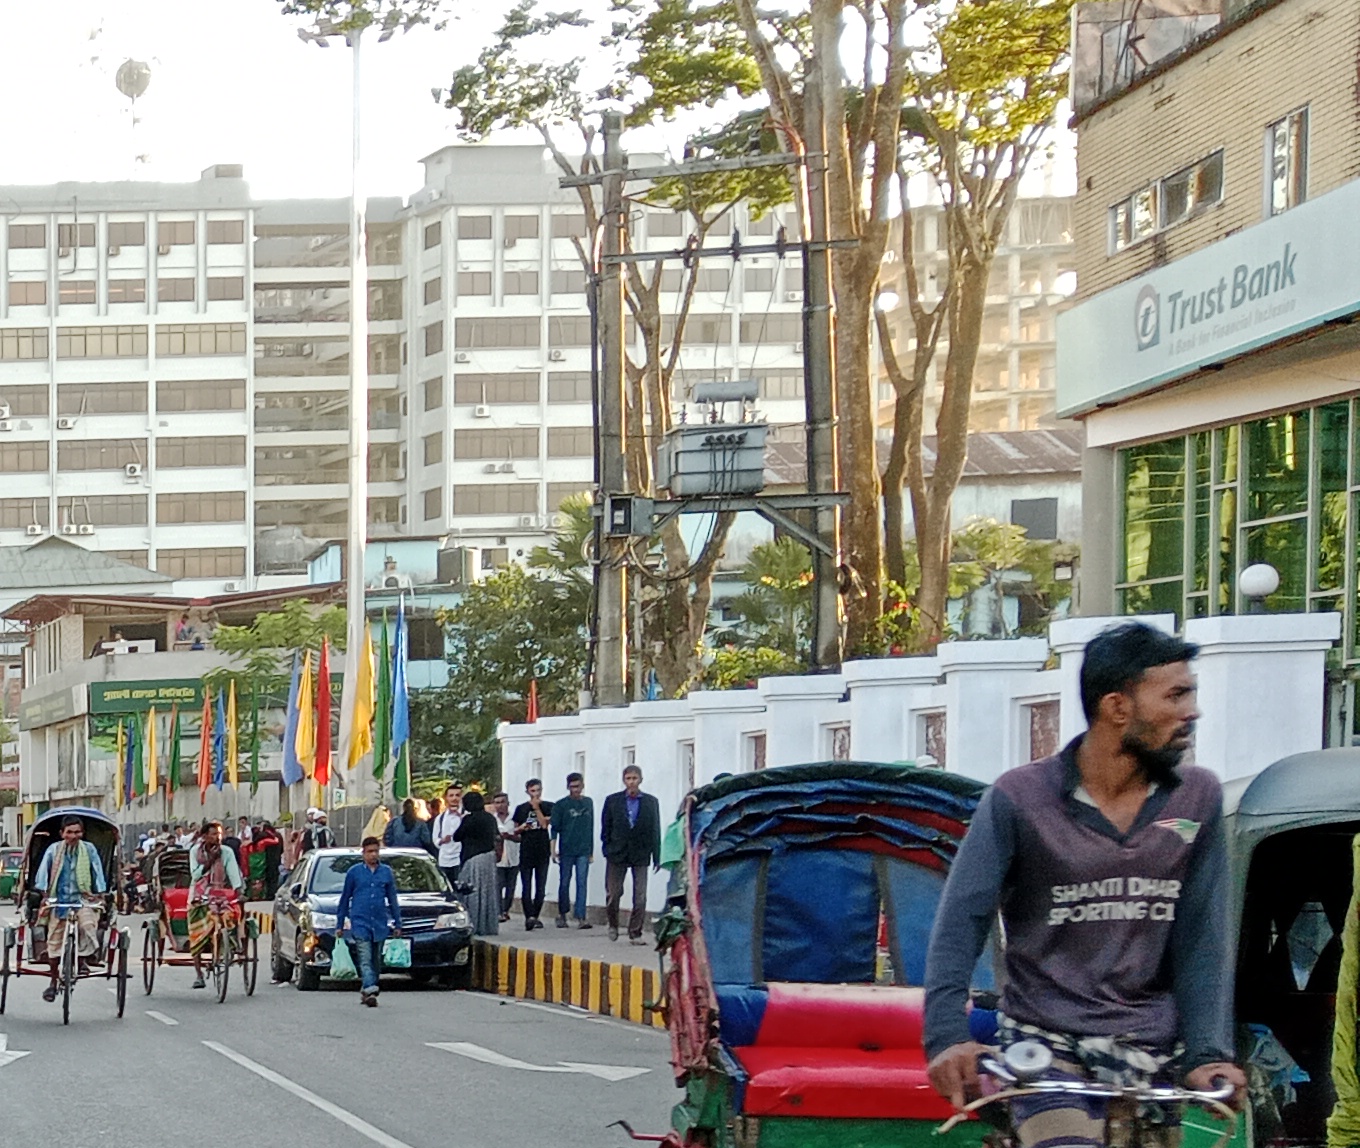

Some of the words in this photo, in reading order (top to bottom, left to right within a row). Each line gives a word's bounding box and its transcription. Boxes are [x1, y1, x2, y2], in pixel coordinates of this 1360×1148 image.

[1167, 276, 1227, 333] Trust
[1230, 241, 1298, 310] Bank
[1051, 877, 1124, 903] SHANTI
[1127, 876, 1183, 899] DHAR
[1047, 901, 1149, 926] SPORTING
